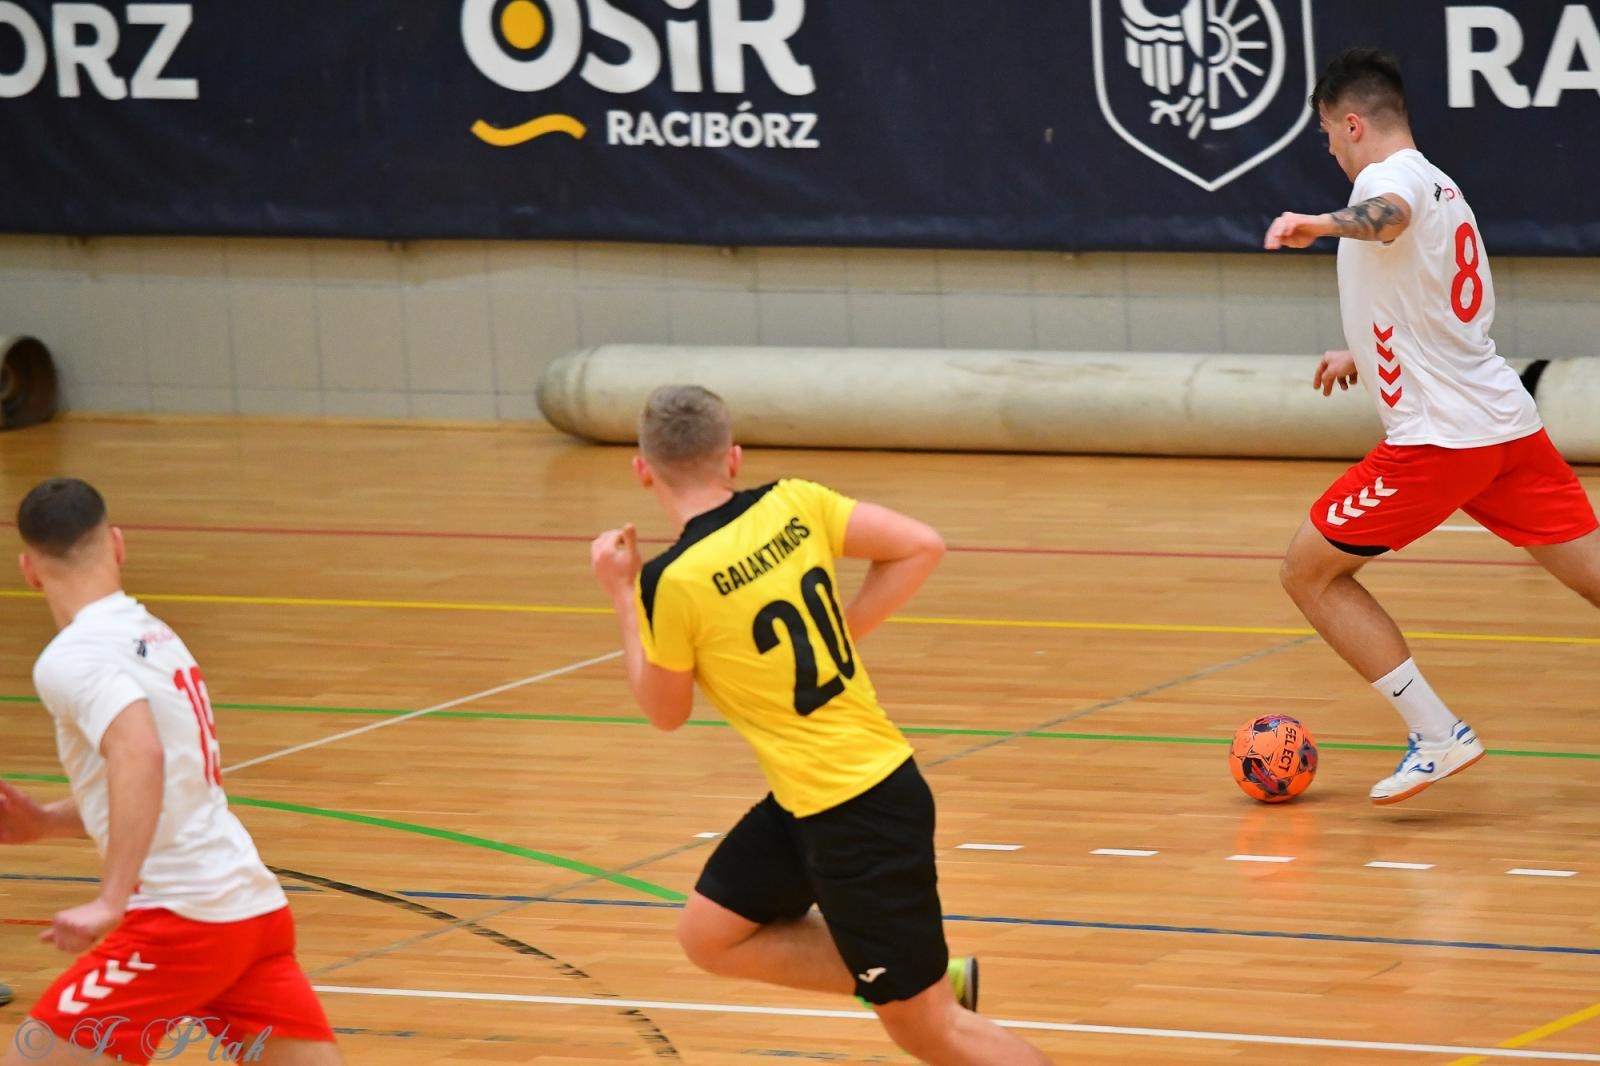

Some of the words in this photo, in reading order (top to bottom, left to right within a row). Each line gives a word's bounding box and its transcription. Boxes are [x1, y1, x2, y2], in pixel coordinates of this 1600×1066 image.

[1445, 5, 1600, 108] RA
[606, 101, 820, 148] RACIBÓRZ
[1451, 222, 1483, 323] 8
[712, 517, 811, 596] GALAKTIKOS
[752, 566, 855, 717] 20
[1278, 727, 1297, 772] SELECT
